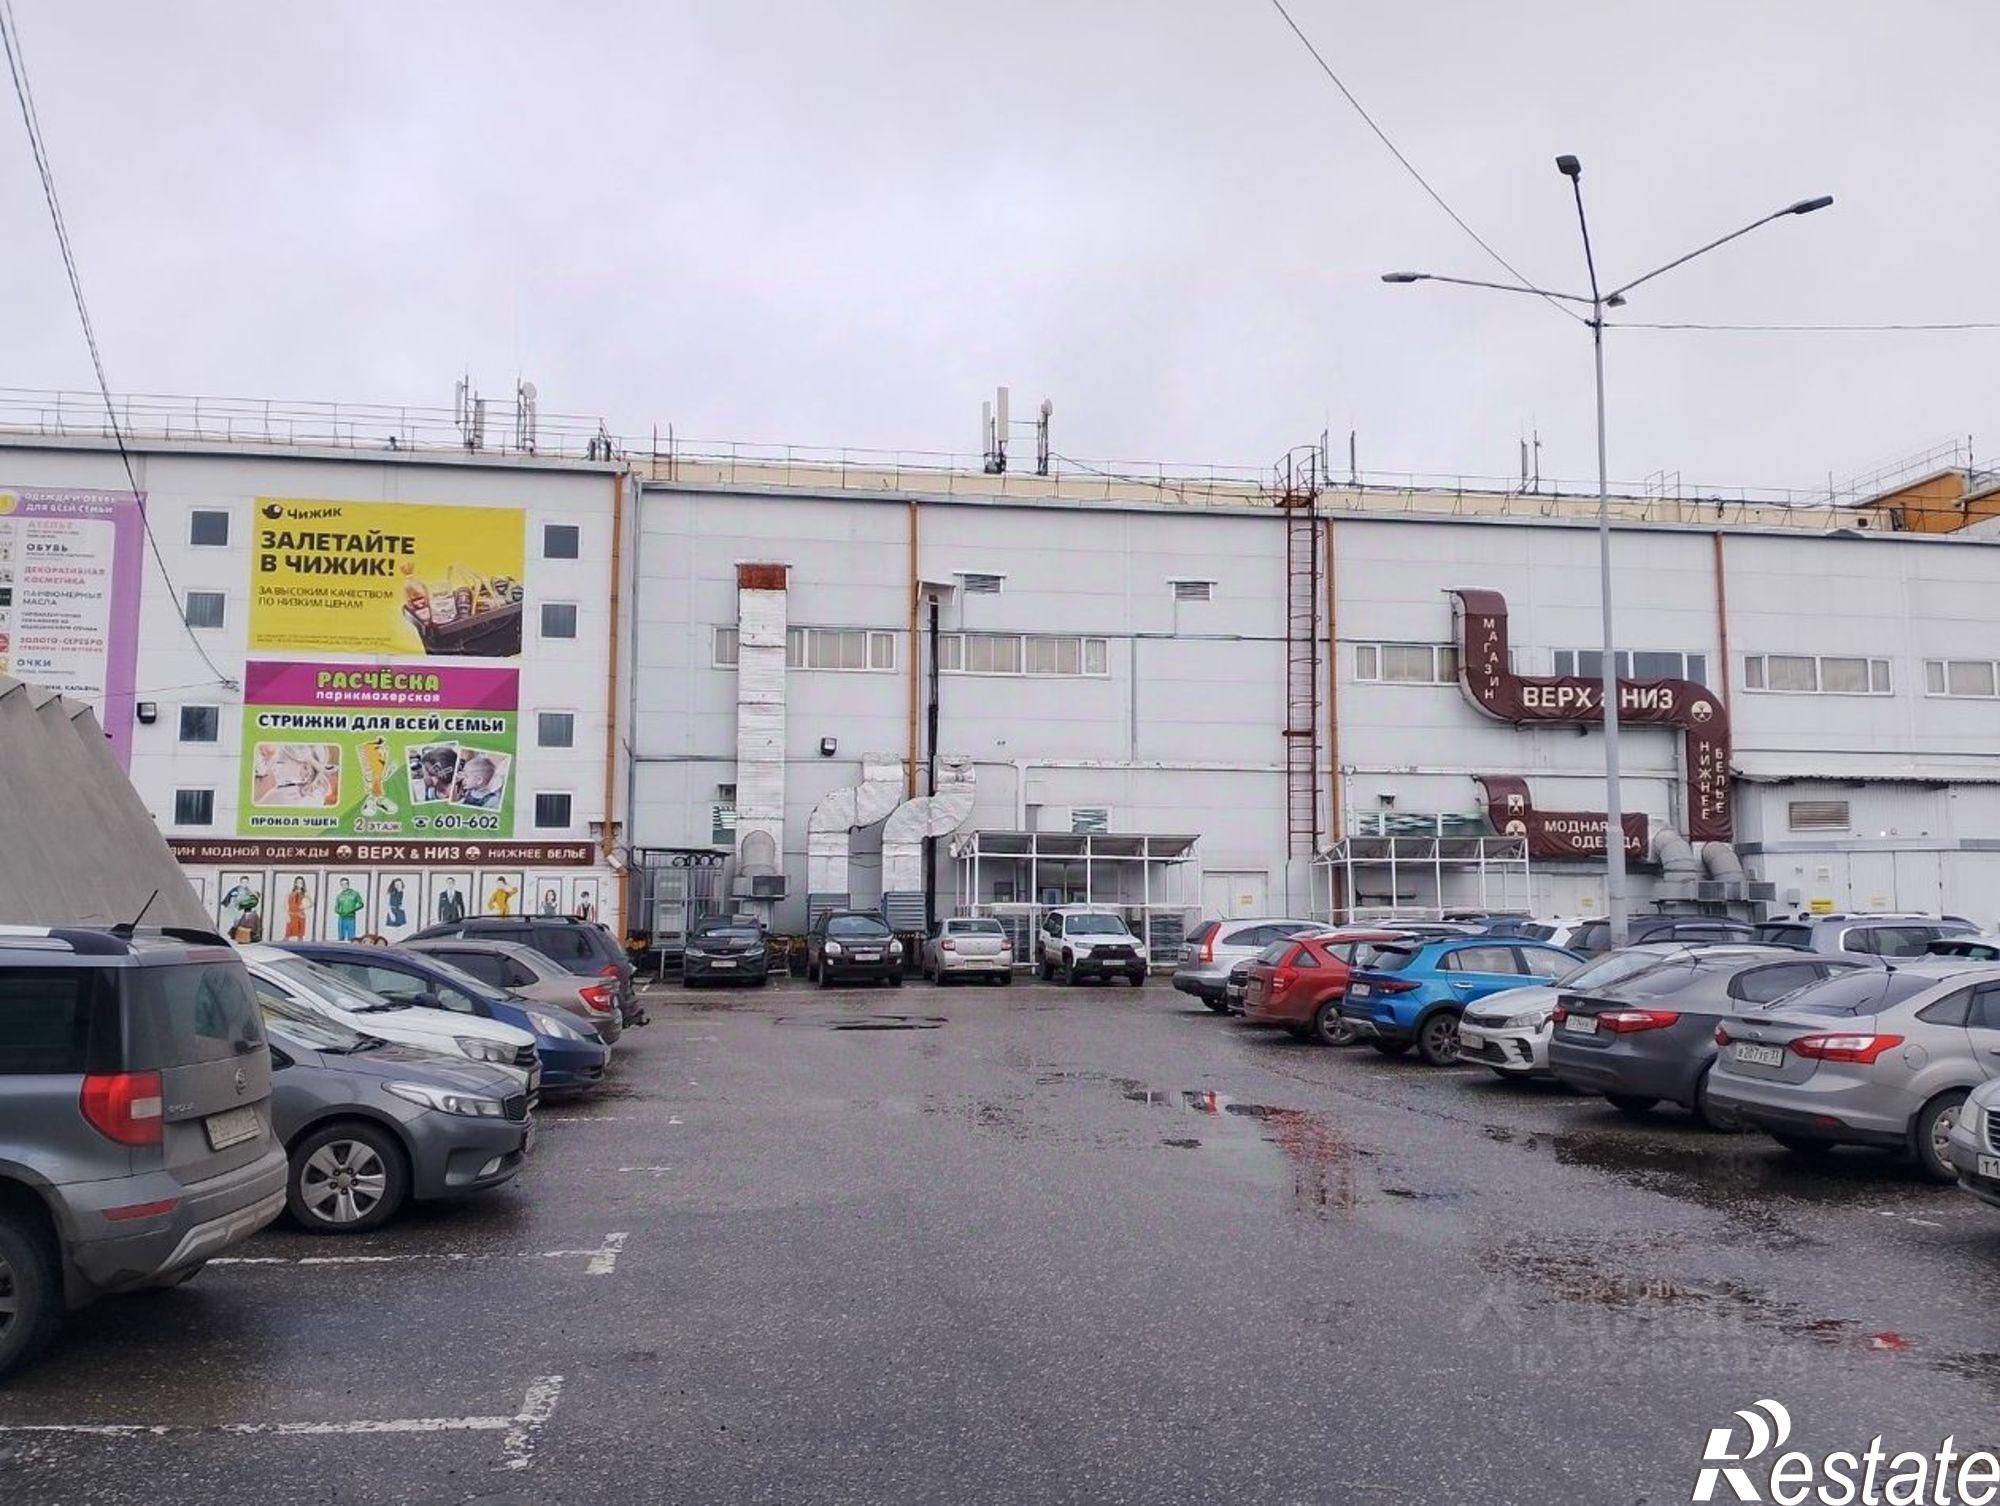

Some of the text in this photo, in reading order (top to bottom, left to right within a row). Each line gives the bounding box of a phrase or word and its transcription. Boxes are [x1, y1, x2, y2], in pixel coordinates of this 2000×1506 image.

[26, 542, 68, 552] ОБУВЬ
[261, 529, 416, 555] ЗАЛЕТАЙТЕ
[24, 566, 105, 575] ДЕКОРАТИВНАЯ
[260, 553, 395, 577] В ЧИЖИК!
[23, 575, 85, 585] КОСМЕТИКА
[259, 585, 394, 599] ЗА ВЫСОКИМ КАЧЕСТВОМ
[23, 598, 57, 606] МАСЛА
[258, 596, 364, 609] ПО НИЗКИМ ЦЕНАМ
[16, 658, 52, 668] ОЧКИ
[1482, 617, 1499, 700] МАГАЗИН
[317, 668, 441, 692] РАСЧЁСКА
[315, 690, 441, 703] парикмахерская
[1522, 686, 1593, 707] ВЕРХ
[1620, 687, 1673, 710] НИЗ
[257, 713, 504, 732] СТРИЖКИ ДЛЯ ВСЕЙ СЕМЬИ
[1698, 740, 1712, 821] НИЖНЕЕ
[1714, 747, 1727, 814] БЕЛЬЕ
[251, 816, 338, 827] ПРОКОЛ УШЕК
[355, 818, 364, 831] 2
[434, 815, 499, 829] 601-602
[1571, 835, 1641, 850] ОДЕДА
[200, 845, 260, 858] МОДНОЙ
[265, 846, 330, 859] ОДЕЖДЫ
[357, 846, 405, 859] ВЕРХ
[424, 846, 460, 859] НИЗ
[488, 848, 542, 859] НИЖНЕЕ
